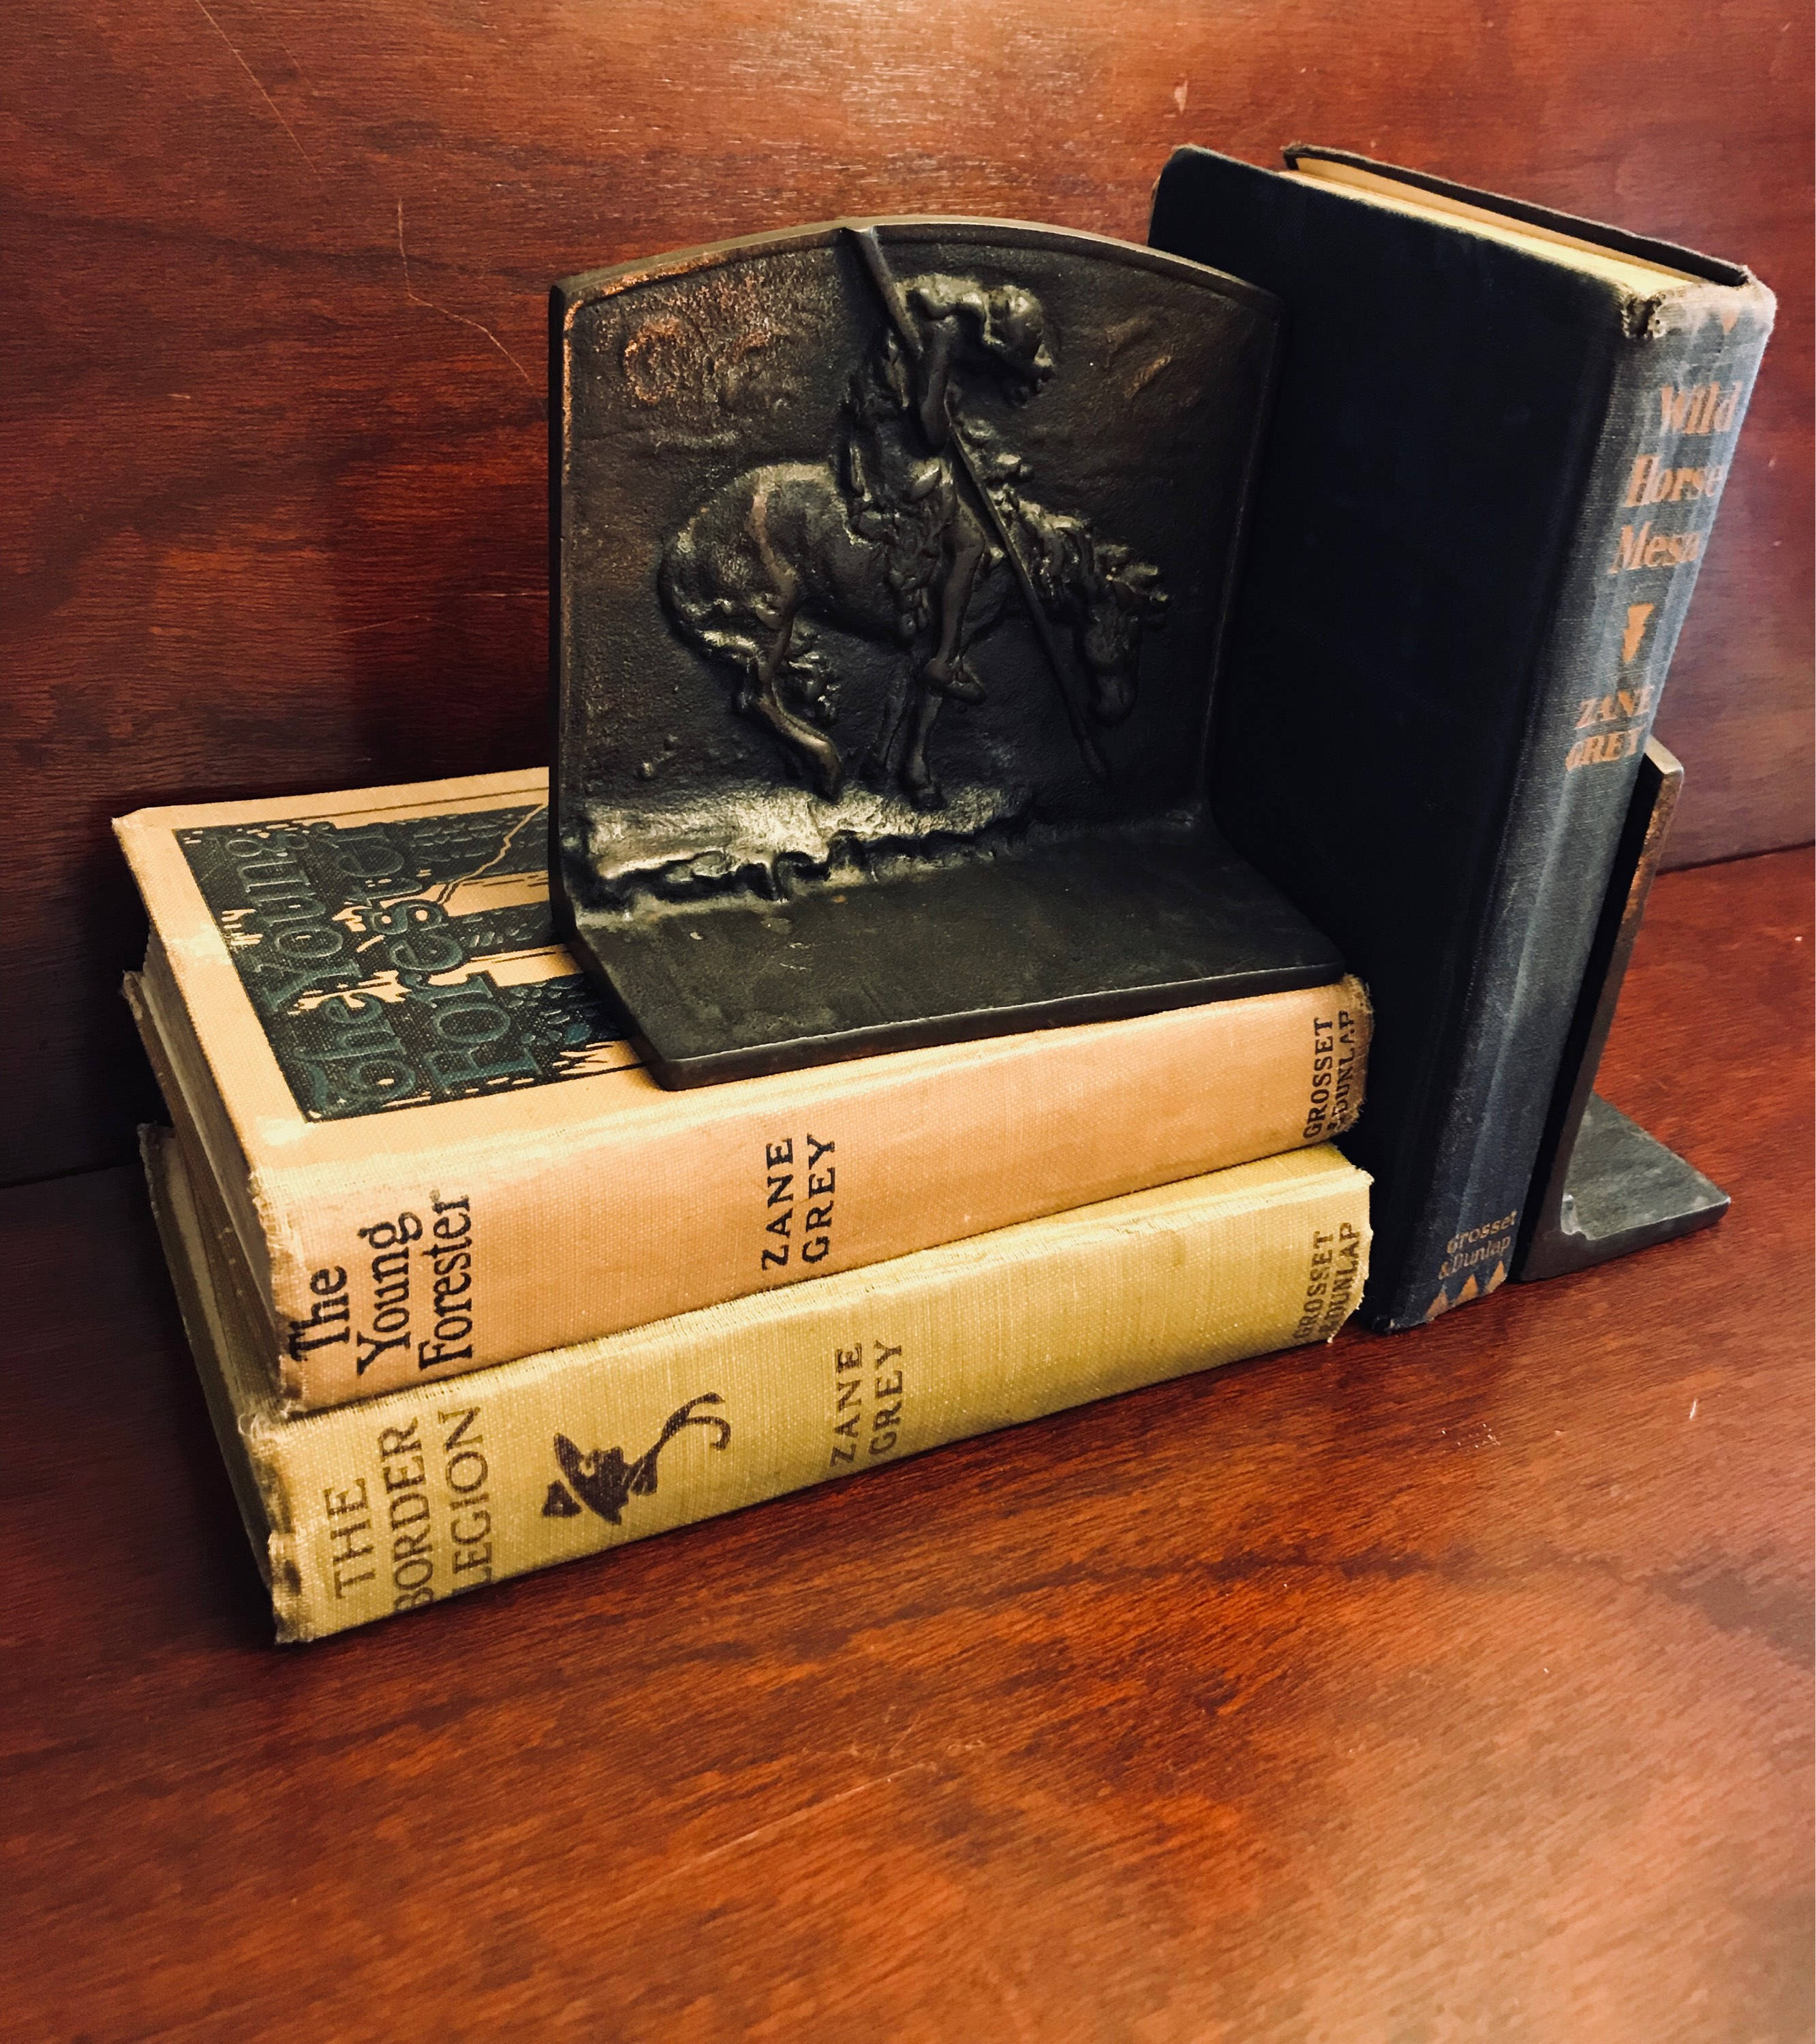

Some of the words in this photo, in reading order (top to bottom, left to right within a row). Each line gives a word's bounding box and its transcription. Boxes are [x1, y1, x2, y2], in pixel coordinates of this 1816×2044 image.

[1659, 382, 1742, 437] Wild
[1625, 454, 1725, 508] Horse
[1607, 521, 1700, 574] Mesa
[1565, 723, 1647, 772] GREY
[1575, 683, 1655, 730] ZANE
[224, 831, 363, 1013] Young
[314, 822, 542, 1089] Forester
[293, 991, 416, 1116] The
[1303, 1017, 1334, 1139] GROSSET
[761, 1137, 794, 1271] ZANE
[801, 1133, 836, 1265] GREY
[1446, 1209, 1518, 1254] Grosset
[288, 1265, 350, 1362] The
[356, 1211, 423, 1376] Young
[418, 1189, 473, 1371] Forester
[1292, 1230, 1334, 1339] GROSSET
[829, 1342, 862, 1468] ZANE
[868, 1340, 903, 1455] GREY
[323, 1478, 375, 1600] THE
[378, 1416, 434, 1613] BORDER
